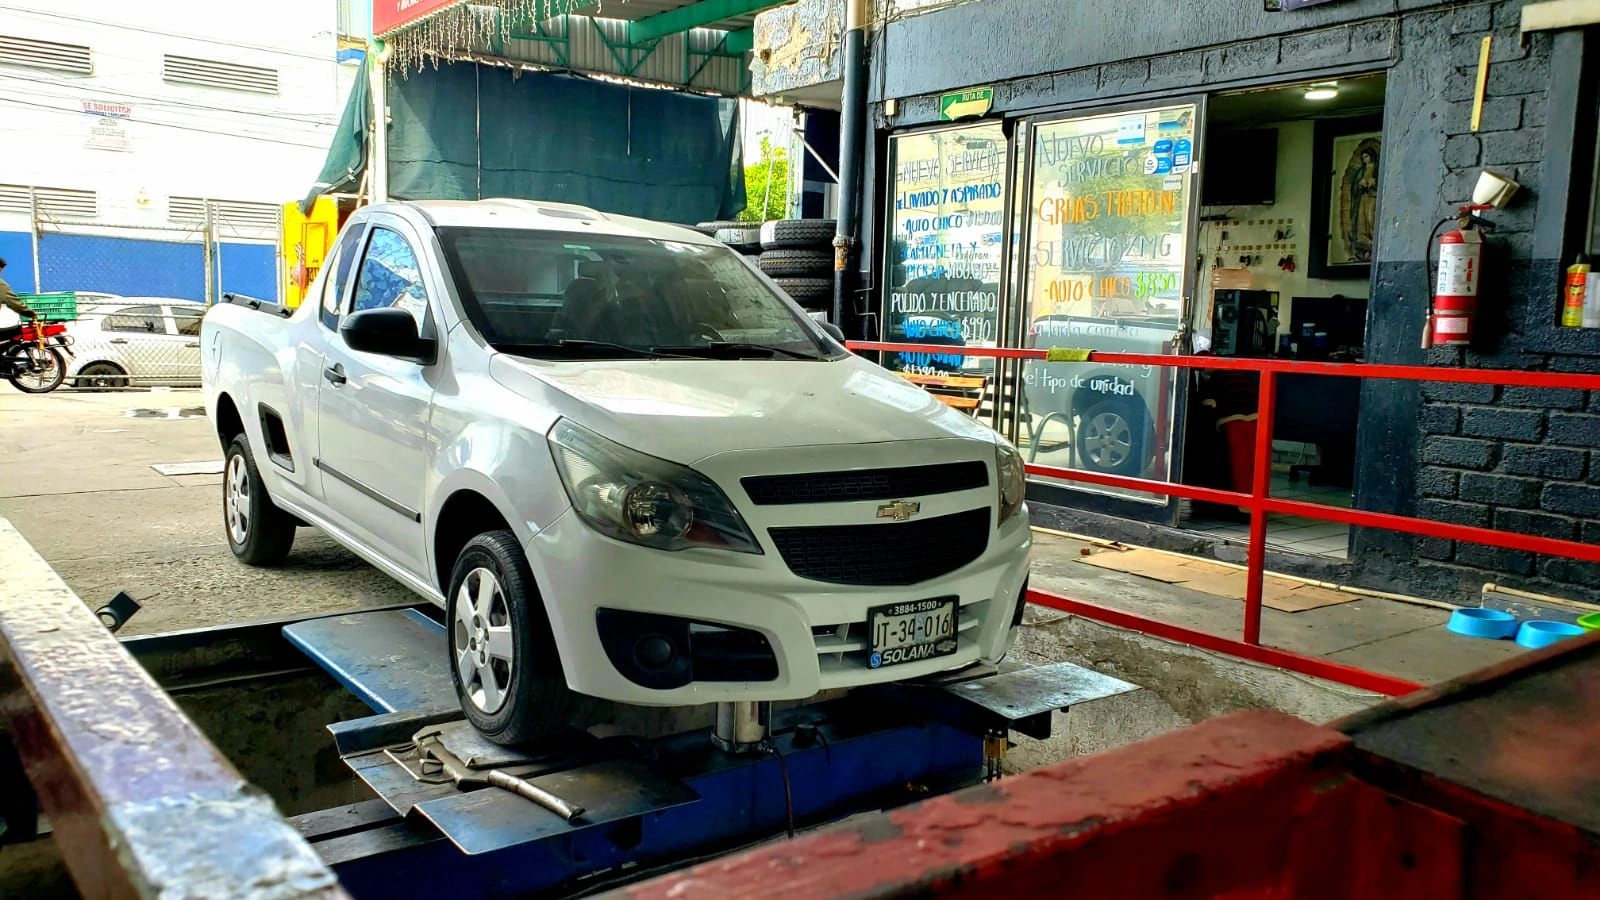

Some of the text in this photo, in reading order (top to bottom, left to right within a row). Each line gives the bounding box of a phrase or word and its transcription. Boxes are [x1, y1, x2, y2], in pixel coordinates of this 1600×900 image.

[976, 91, 985, 99] DE
[1038, 131, 1104, 168] NUEVO
[1057, 156, 1139, 188] SERVICIO
[903, 189, 940, 210] LAVADO
[942, 188, 949, 205] Y
[950, 182, 1002, 204] ASPIRADO
[1038, 193, 1099, 226] GRUAS
[932, 214, 964, 231] CHICO
[1087, 275, 1133, 299] CHICO
[891, 290, 996, 313] PULIDO Y ENCERADO
[960, 315, 991, 342] $990
[1025, 367, 1135, 397] el tipo de unidad
[894, 600, 937, 616] 3884-1500
[882, 643, 936, 665] SOLANA
